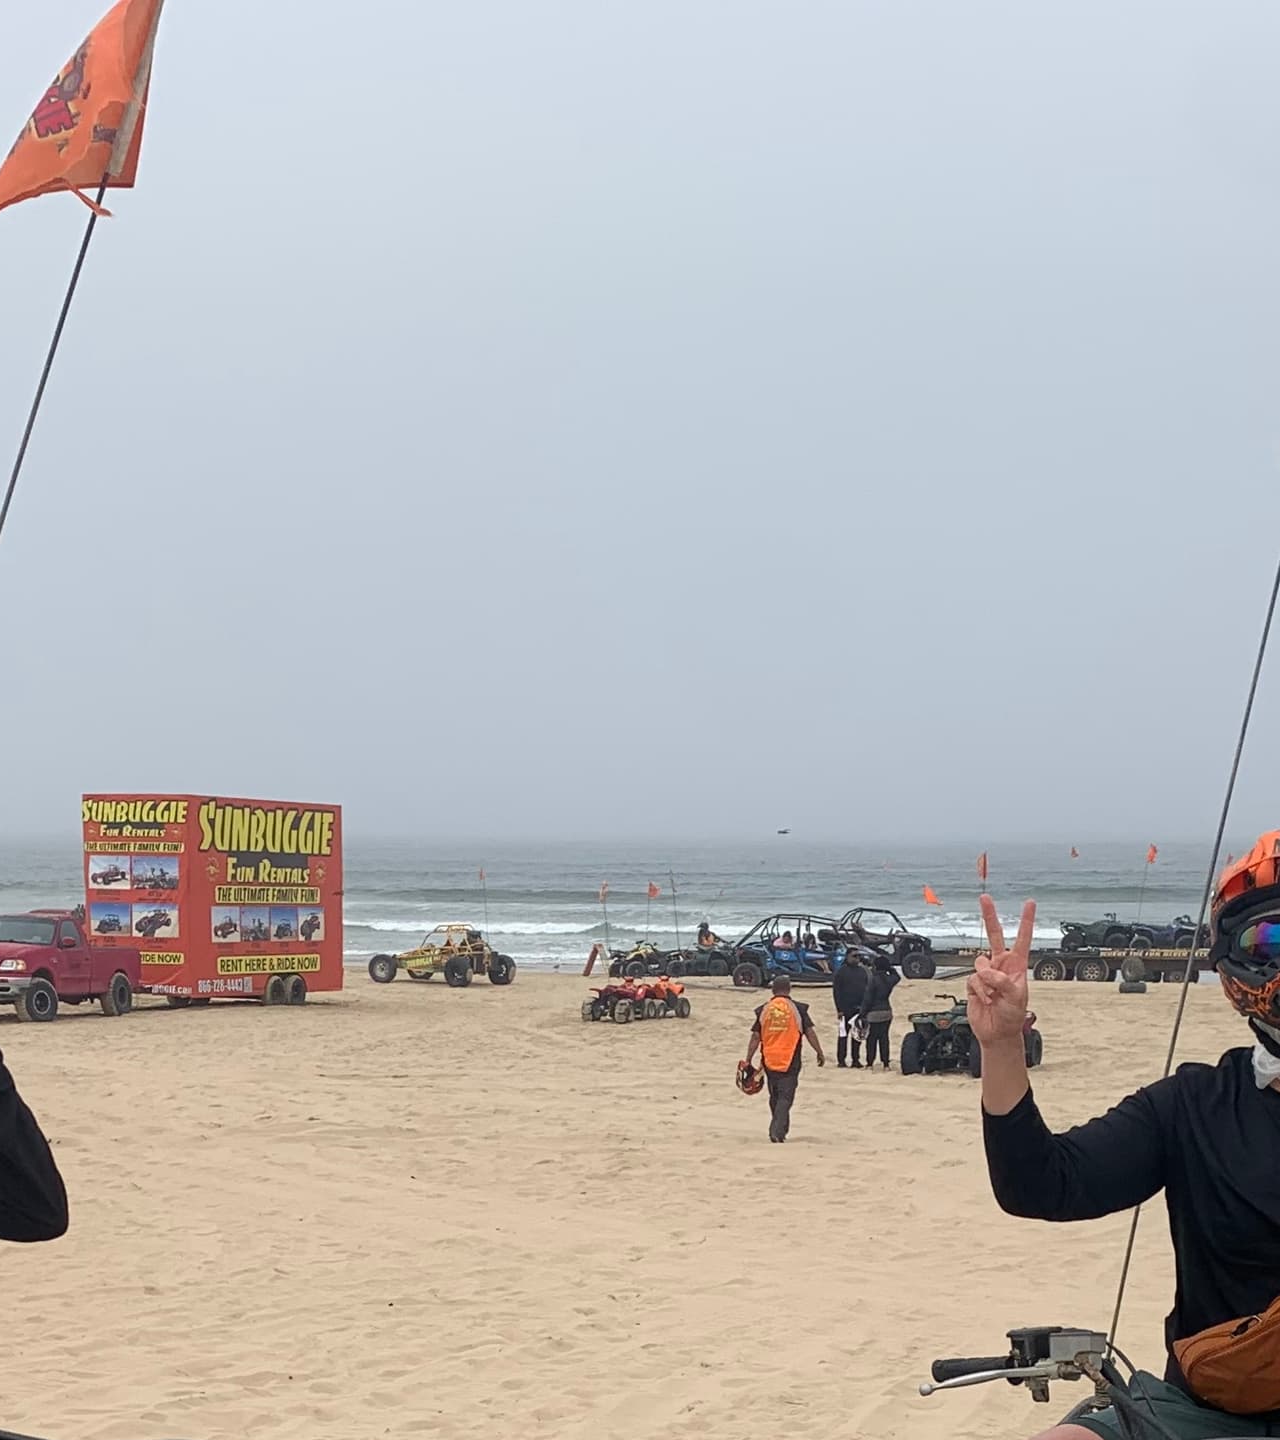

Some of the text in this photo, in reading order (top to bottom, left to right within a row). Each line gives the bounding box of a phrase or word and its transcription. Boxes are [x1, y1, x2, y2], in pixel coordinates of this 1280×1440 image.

[81, 799, 188, 823] SUNBUGGIE
[199, 800, 335, 855] SUNBUGGIE
[99, 842, 131, 852] ULTIMATE
[133, 843, 161, 852] FAMILY
[217, 887, 319, 902] THE ULTIMATE FAMILY FUN!
[140, 953, 181, 963] IDE NOW
[220, 957, 319, 972] RENT HERE & RIDE NOW
